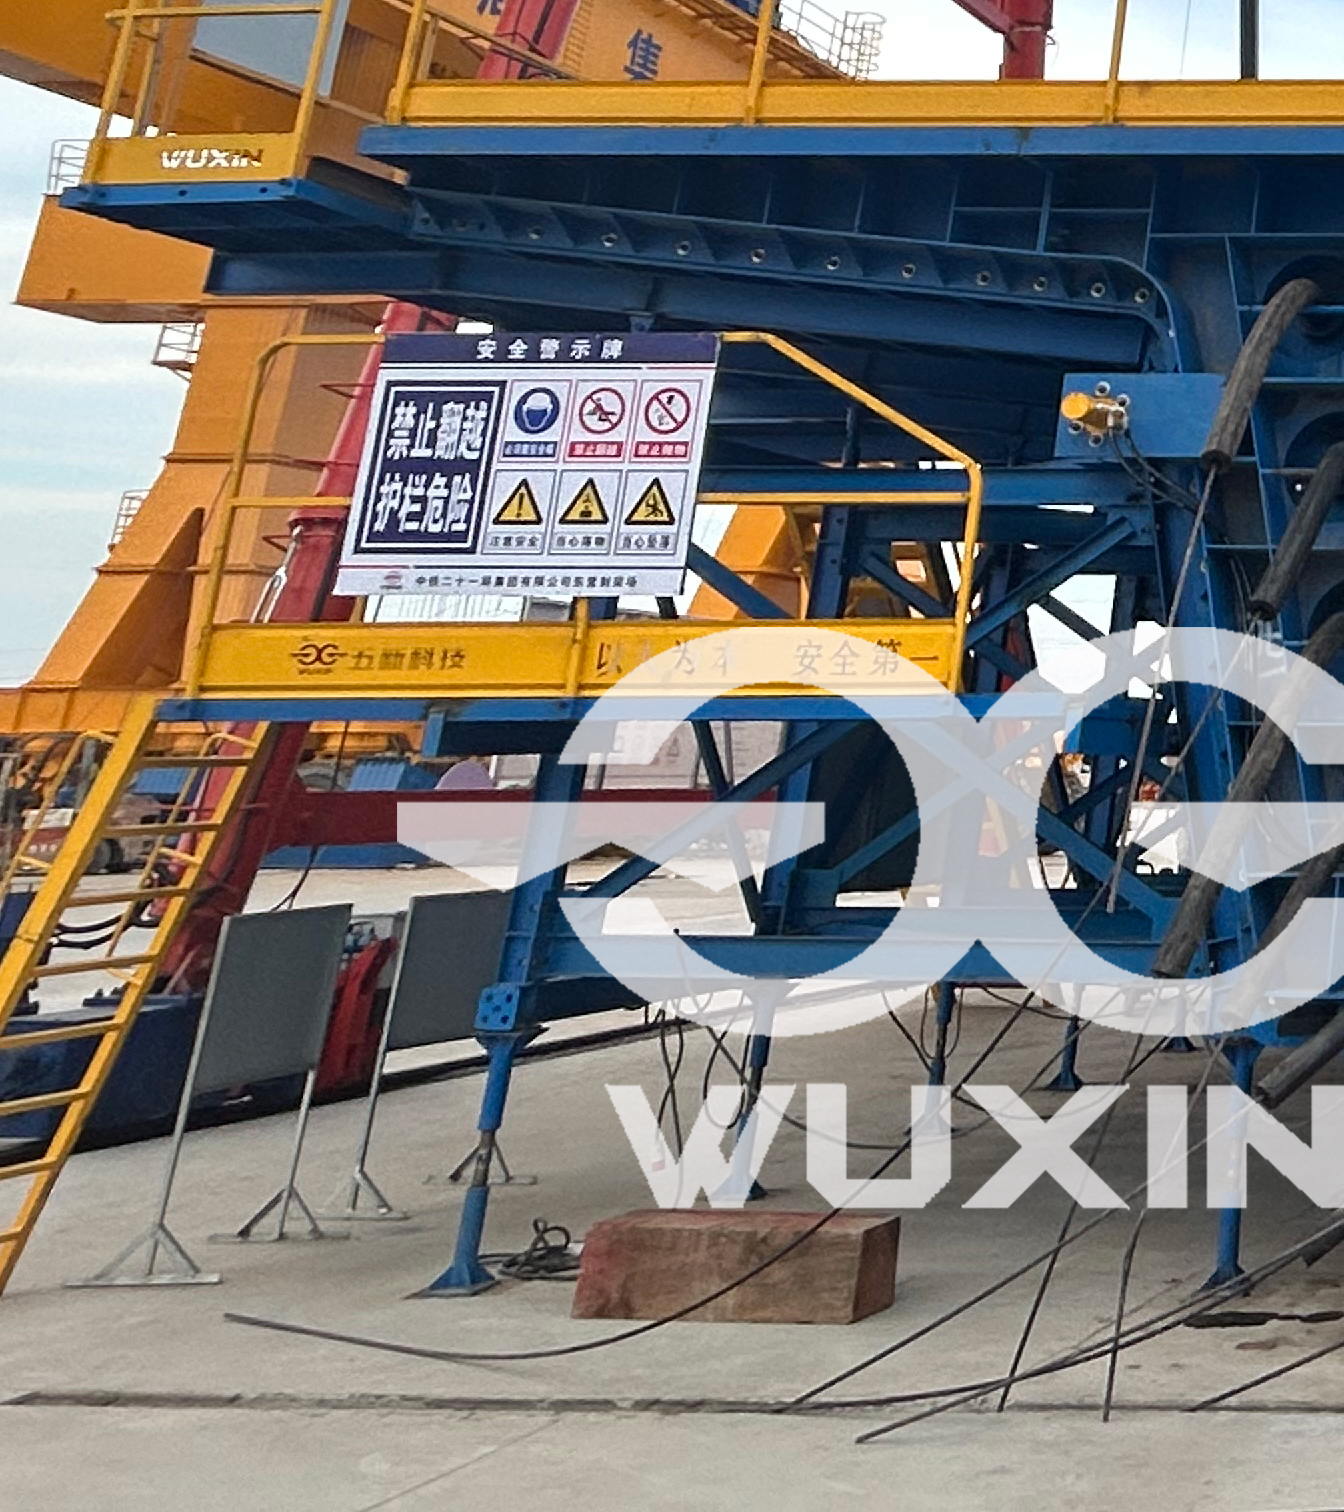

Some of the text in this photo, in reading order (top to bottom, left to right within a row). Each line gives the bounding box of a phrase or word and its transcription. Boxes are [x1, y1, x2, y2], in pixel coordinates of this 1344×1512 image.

[160, 148, 264, 169] WUXIN
[476, 338, 624, 360] 安全警示牌
[385, 400, 488, 461] 禁止翻越
[373, 472, 474, 533] 护栏危险
[791, 638, 940, 678] 安全第一
